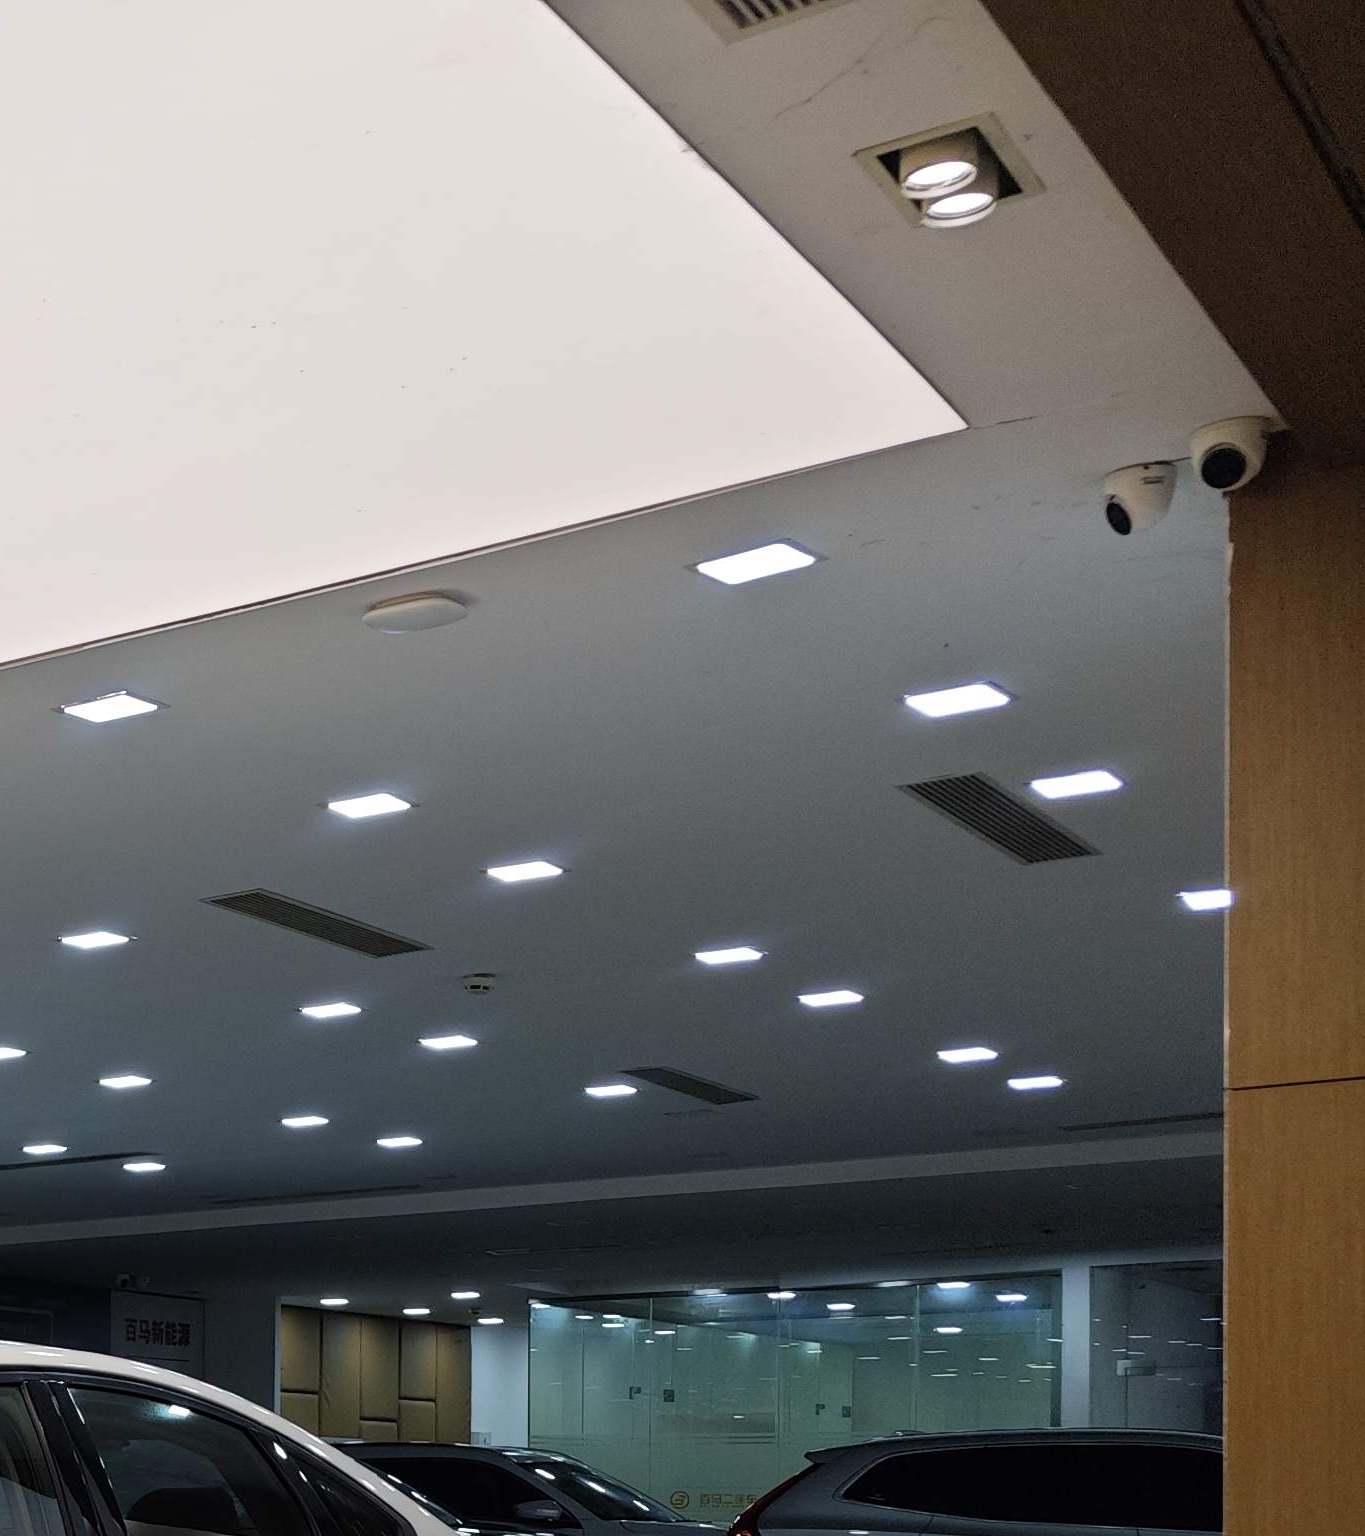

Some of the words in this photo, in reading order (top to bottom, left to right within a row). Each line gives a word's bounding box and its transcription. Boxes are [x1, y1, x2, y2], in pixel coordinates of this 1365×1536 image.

[125, 1317, 191, 1347] 百马新能源
